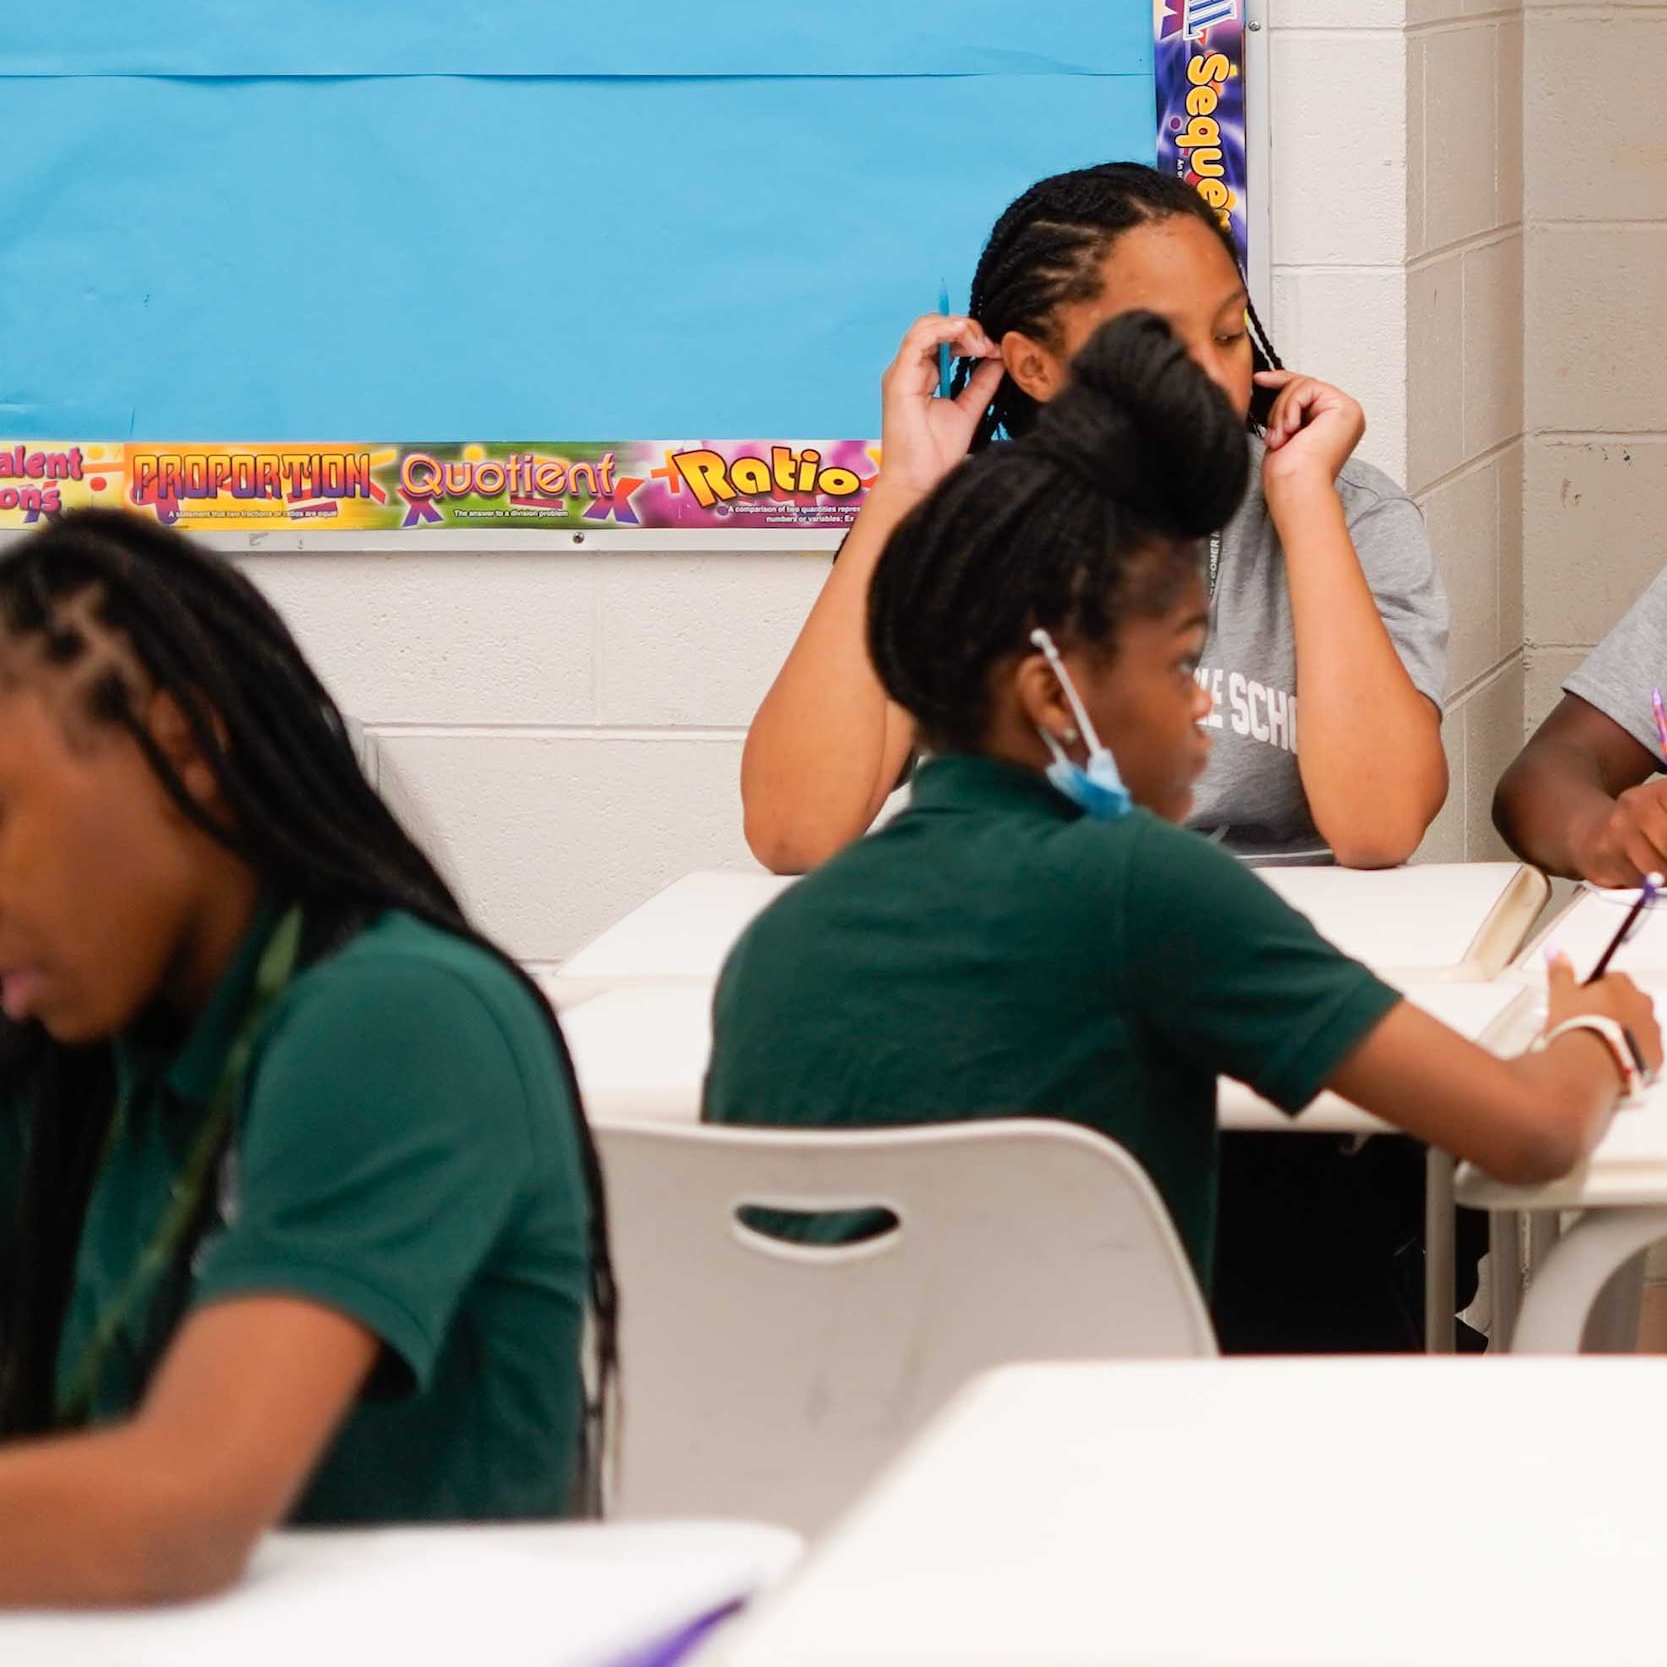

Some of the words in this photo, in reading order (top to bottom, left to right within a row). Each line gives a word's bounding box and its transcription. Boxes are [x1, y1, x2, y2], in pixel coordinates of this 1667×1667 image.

[1175, 53, 1233, 231] Seque
[132, 453, 370, 502] PROPORTION
[401, 452, 618, 501] Quotient
[671, 446, 862, 508] Ratio
